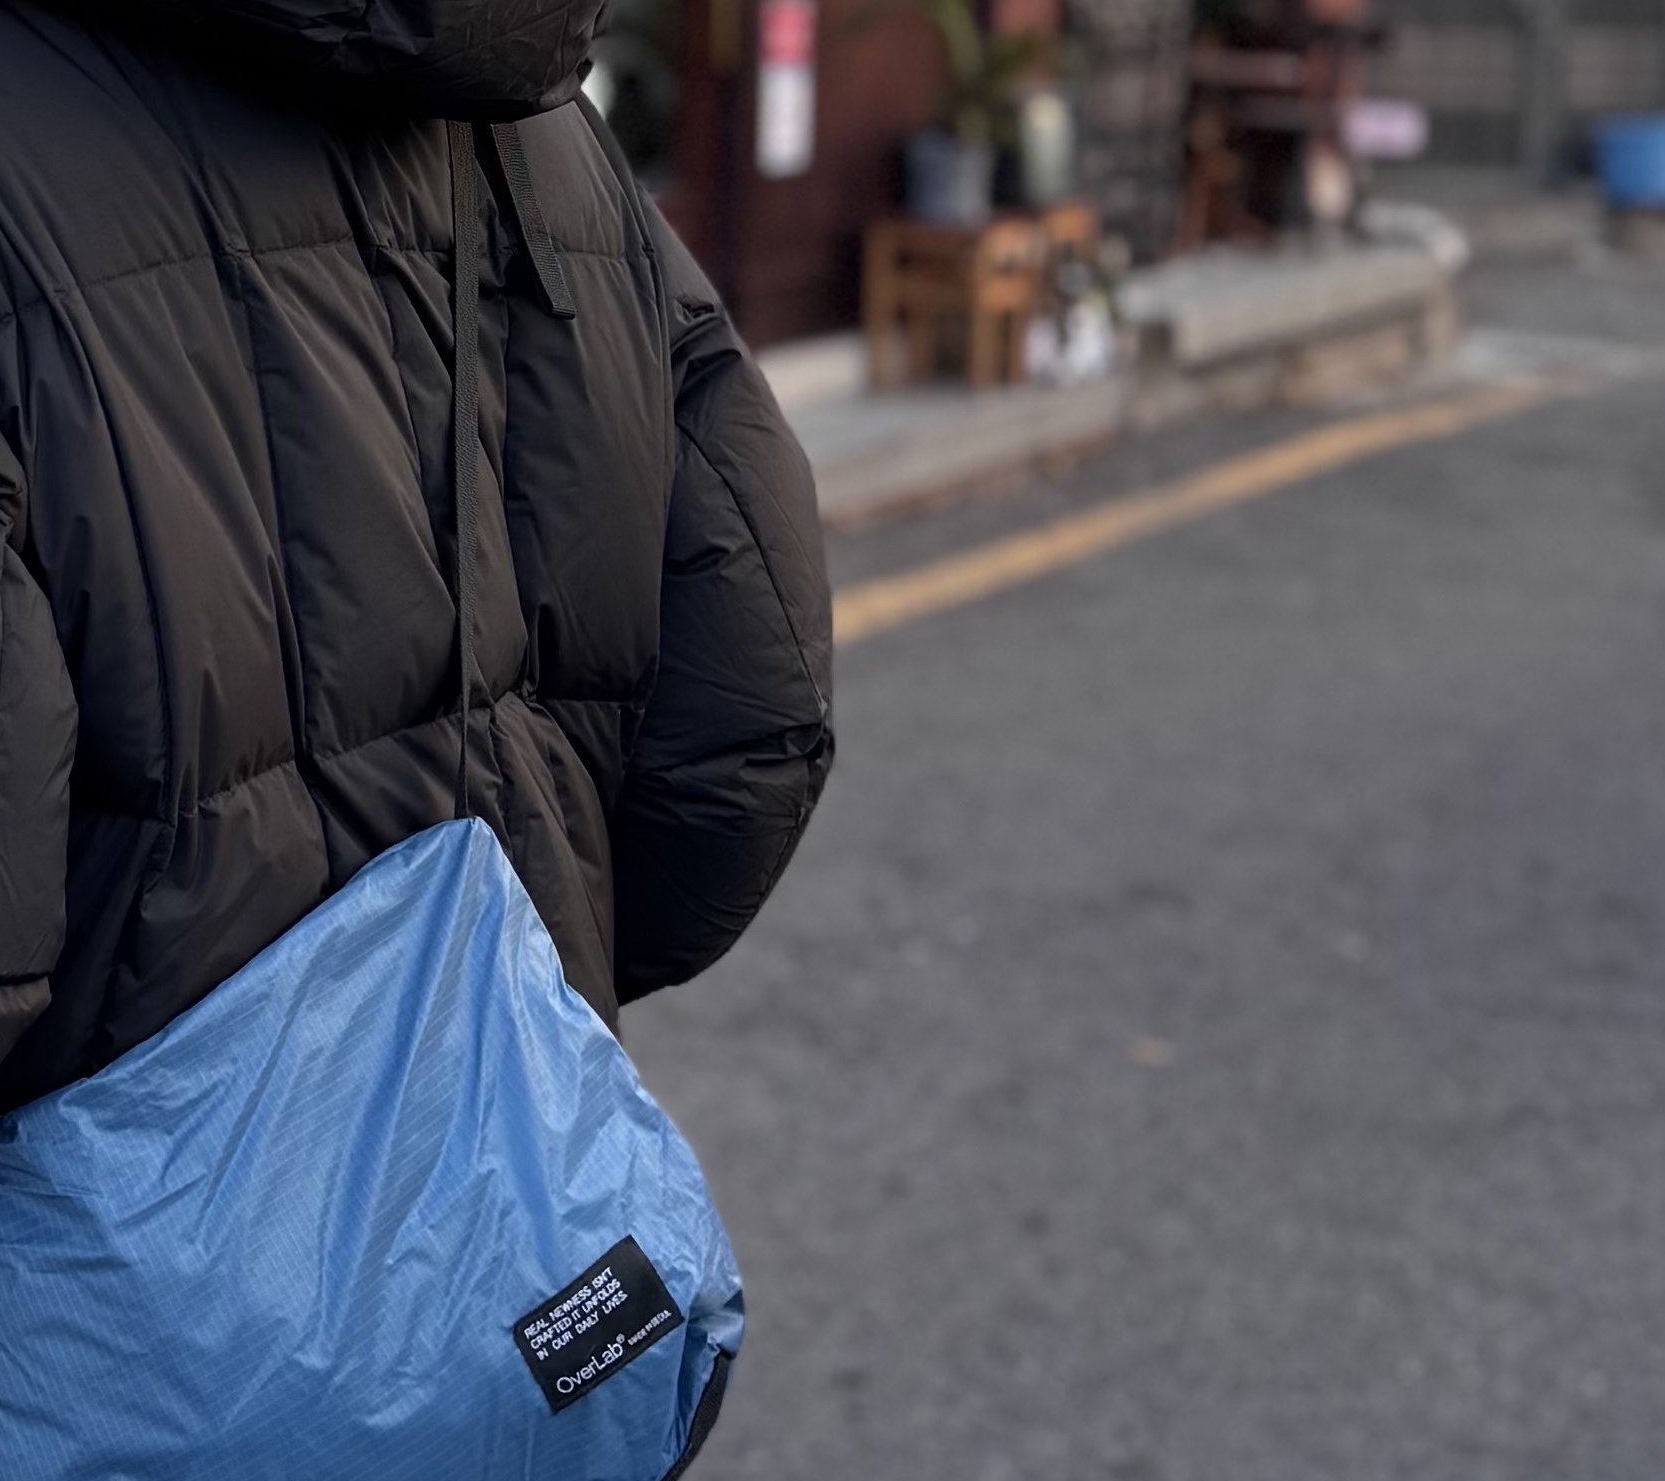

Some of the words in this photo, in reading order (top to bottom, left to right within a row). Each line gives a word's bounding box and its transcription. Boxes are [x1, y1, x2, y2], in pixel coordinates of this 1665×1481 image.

[524, 1318, 549, 1339] REAL
[549, 1286, 591, 1321] NEWNESS
[571, 1309, 581, 1321] IT
[582, 1279, 621, 1313] UNFOLDS
[536, 1348, 549, 1361] IN
[552, 1331, 574, 1350] OUR
[575, 1311, 599, 1334] DAILY
